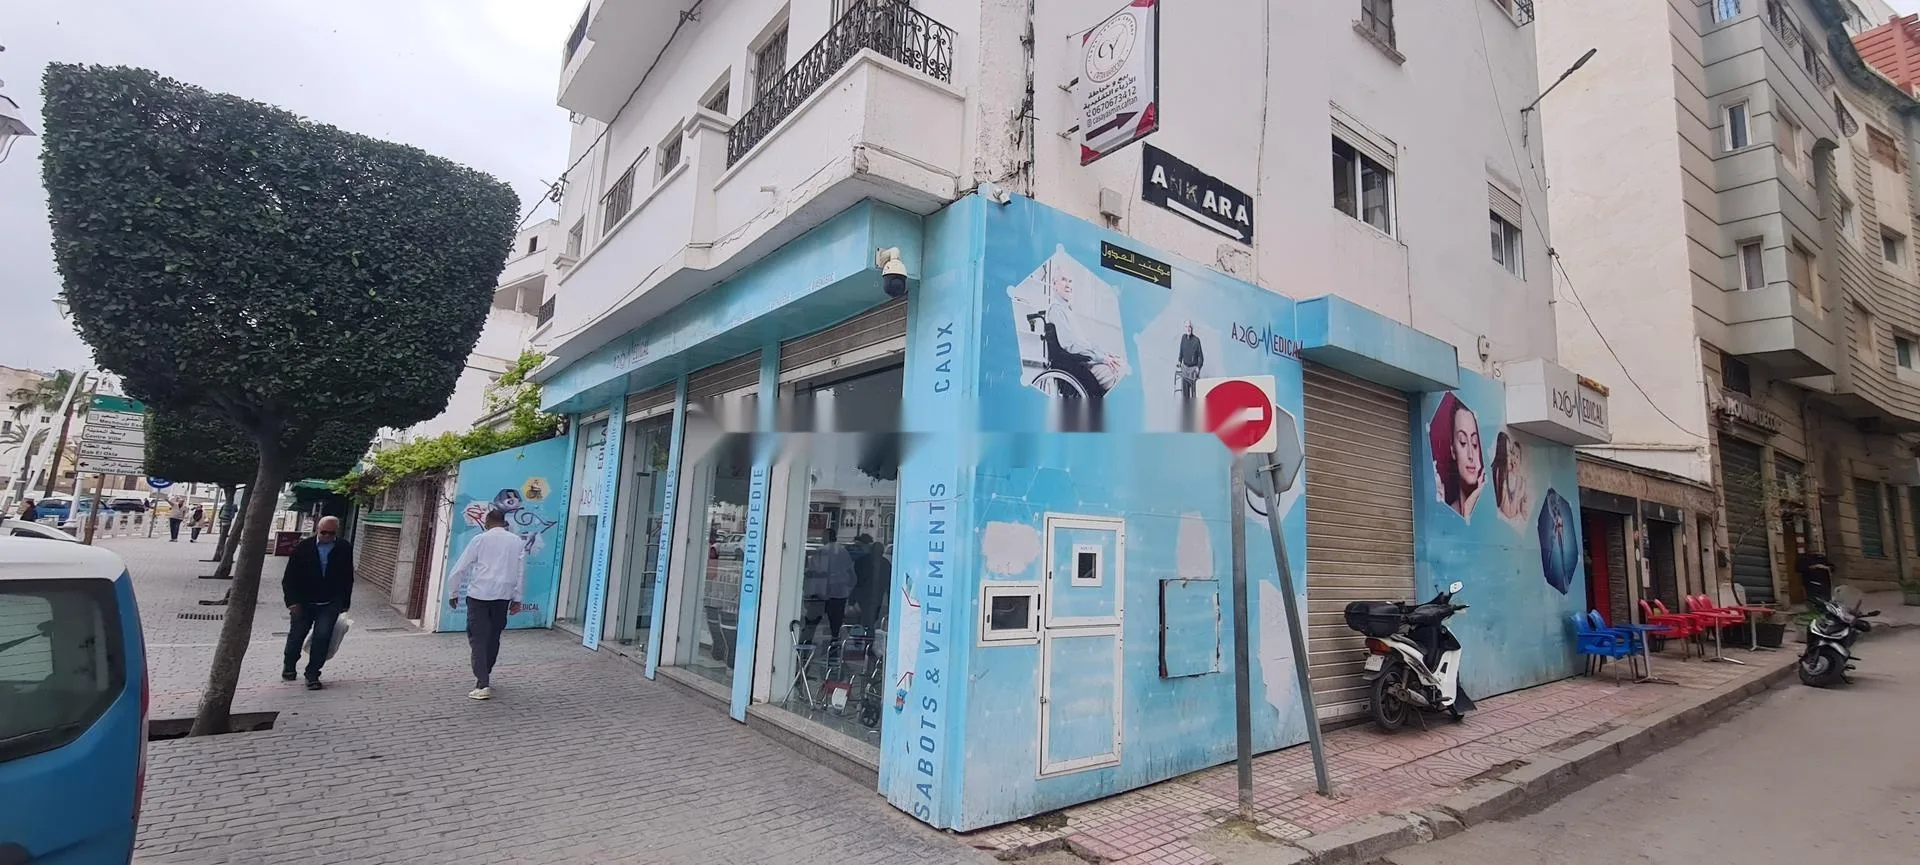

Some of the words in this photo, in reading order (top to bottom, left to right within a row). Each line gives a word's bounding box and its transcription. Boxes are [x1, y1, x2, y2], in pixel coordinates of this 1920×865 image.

[1092, 86, 1137, 116] 0670673412
[1102, 244, 1135, 264] العدول
[657, 469, 675, 584] COSMETIQUES
[743, 468, 764, 593] ORTHOPEDIE
[925, 483, 946, 654] VETEMENTS
[925, 667, 940, 685] &
[914, 695, 938, 821] SABOTS
